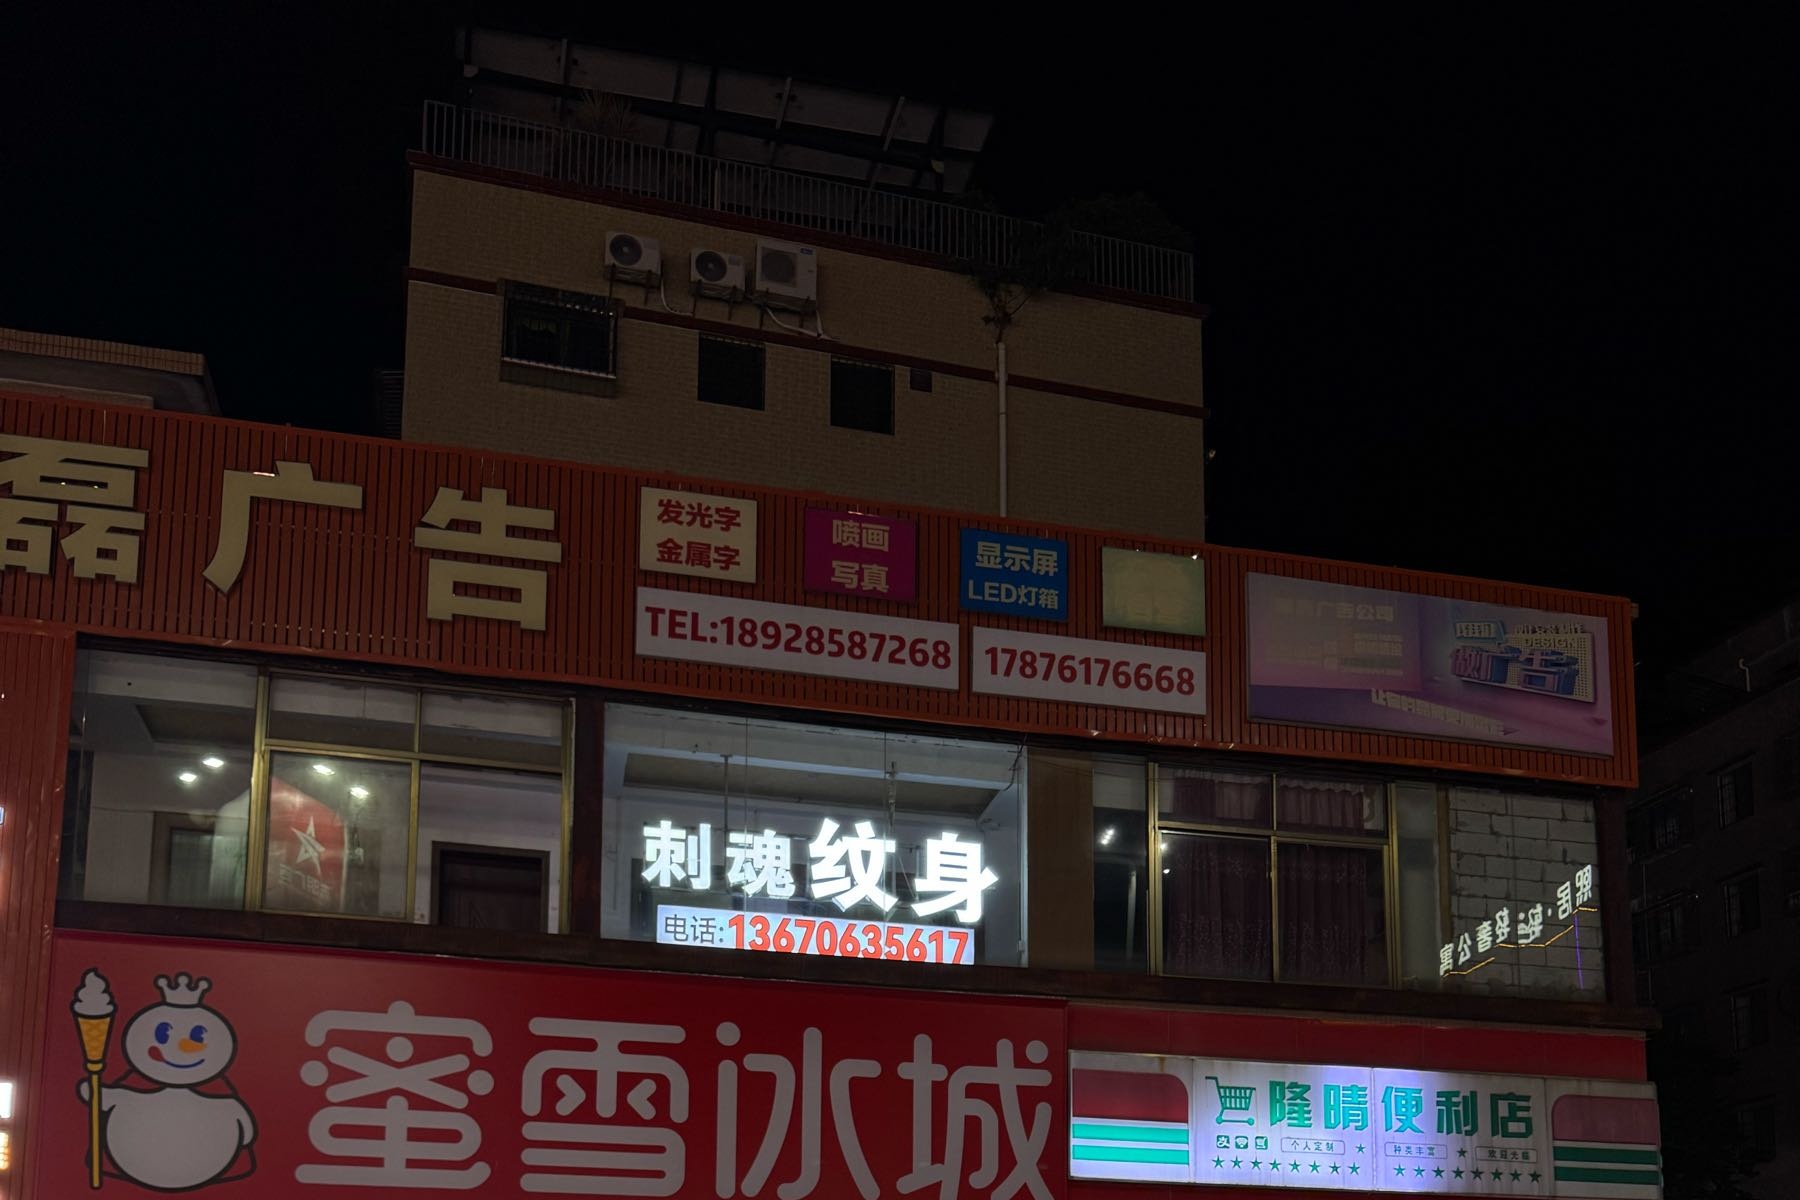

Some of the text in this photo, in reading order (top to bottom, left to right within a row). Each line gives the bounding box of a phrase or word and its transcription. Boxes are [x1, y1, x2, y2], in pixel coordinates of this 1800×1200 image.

[656, 498, 742, 532] 发光字
[831, 519, 891, 553] 喷画
[655, 537, 741, 572] 金属字
[974, 540, 1060, 577] 显示屏
[830, 560, 890, 594] 写真
[967, 580, 1060, 612] LED灯箱
[644, 605, 953, 671] TEL:18928587268
[983, 646, 1196, 697] 17876176668
[641, 817, 998, 925] 刺魂纹身
[1268, 1080, 1533, 1139] 隆晴便利店
[1291, 1139, 1335, 1153] 个人定制
[1393, 1144, 1436, 1157] 种类丰富
